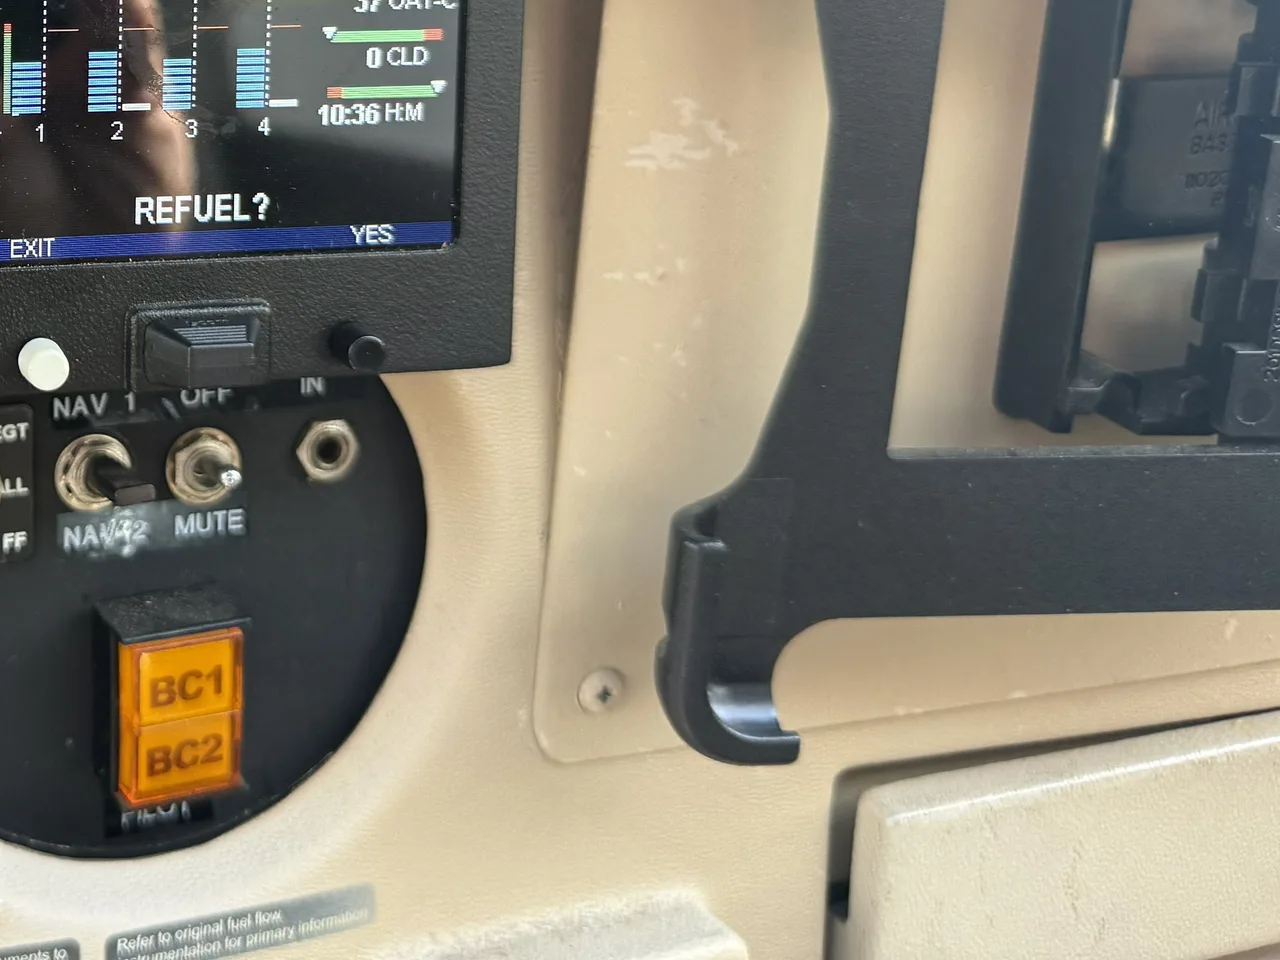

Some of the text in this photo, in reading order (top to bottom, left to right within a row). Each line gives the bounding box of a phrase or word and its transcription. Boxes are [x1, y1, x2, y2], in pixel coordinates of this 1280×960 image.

[366, 47, 430, 69] 0 CLD
[318, 102, 425, 126] 10:36 H:M
[35, 123, 44, 143] 1
[110, 122, 124, 141] 2
[184, 119, 199, 139] 3
[257, 117, 271, 137] 4
[134, 193, 271, 226] REFUEL?
[350, 224, 397, 245] YES
[9, 238, 56, 259] EXIT
[299, 377, 326, 396] IN
[52, 392, 136, 421] NAV 1
[1, 477, 30, 498] LL
[174, 508, 247, 537] MUTE
[2, 531, 28, 554] FF
[150, 664, 224, 709] BC1
[146, 733, 224, 778] BC2
[116, 909, 283, 950] Refer to original fuel flow
[245, 924, 295, 947] primary
[298, 908, 369, 934] information
